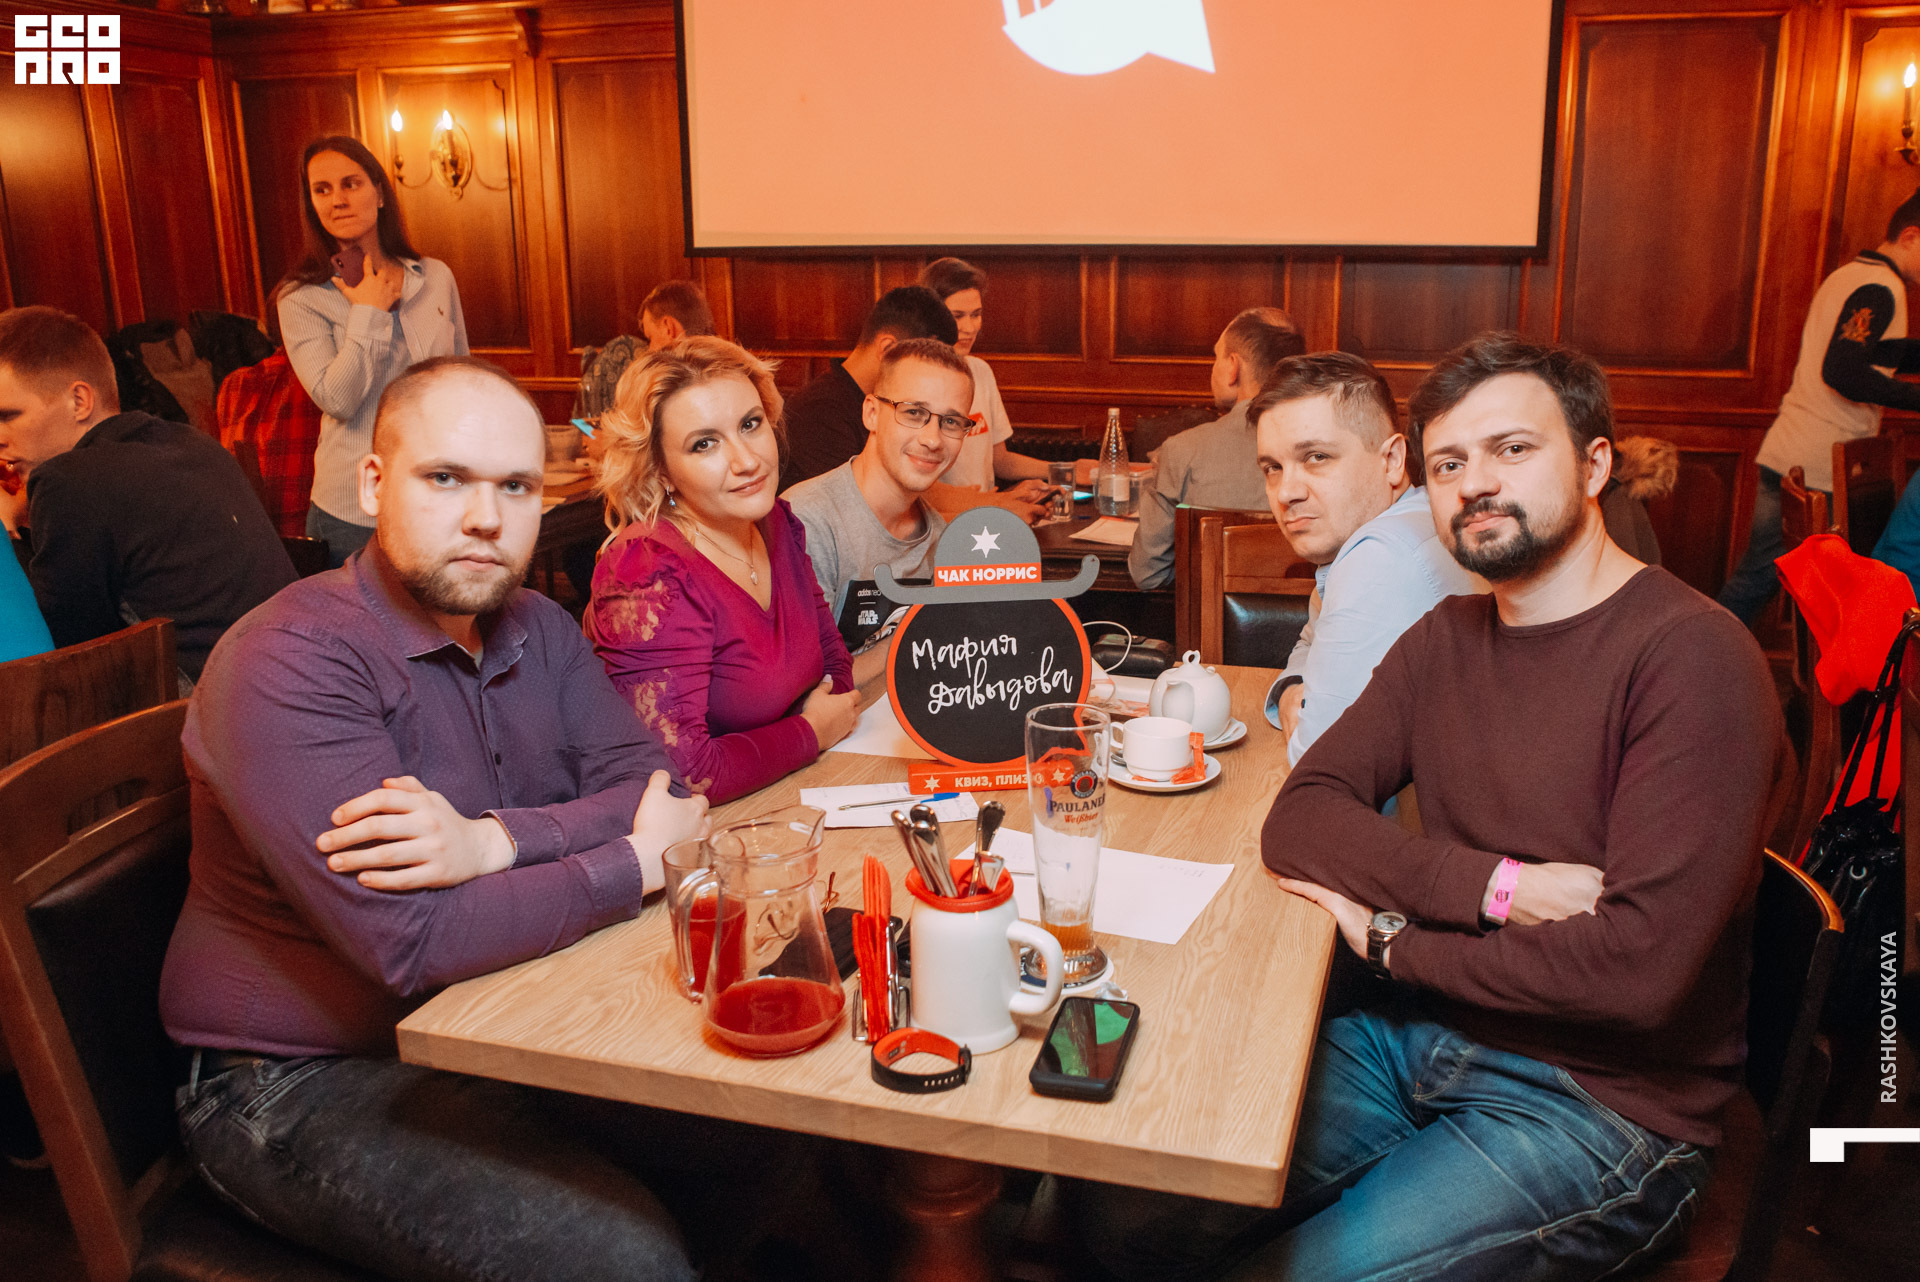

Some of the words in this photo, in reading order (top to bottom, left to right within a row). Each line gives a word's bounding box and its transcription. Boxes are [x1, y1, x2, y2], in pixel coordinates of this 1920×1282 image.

[938, 567, 969, 583] ЧАК
[972, 566, 1038, 582] НОРРИС
[911, 634, 1018, 678] Мафия
[928, 646, 1074, 714] Давыдова
[954, 776, 993, 788] КВИЗ,
